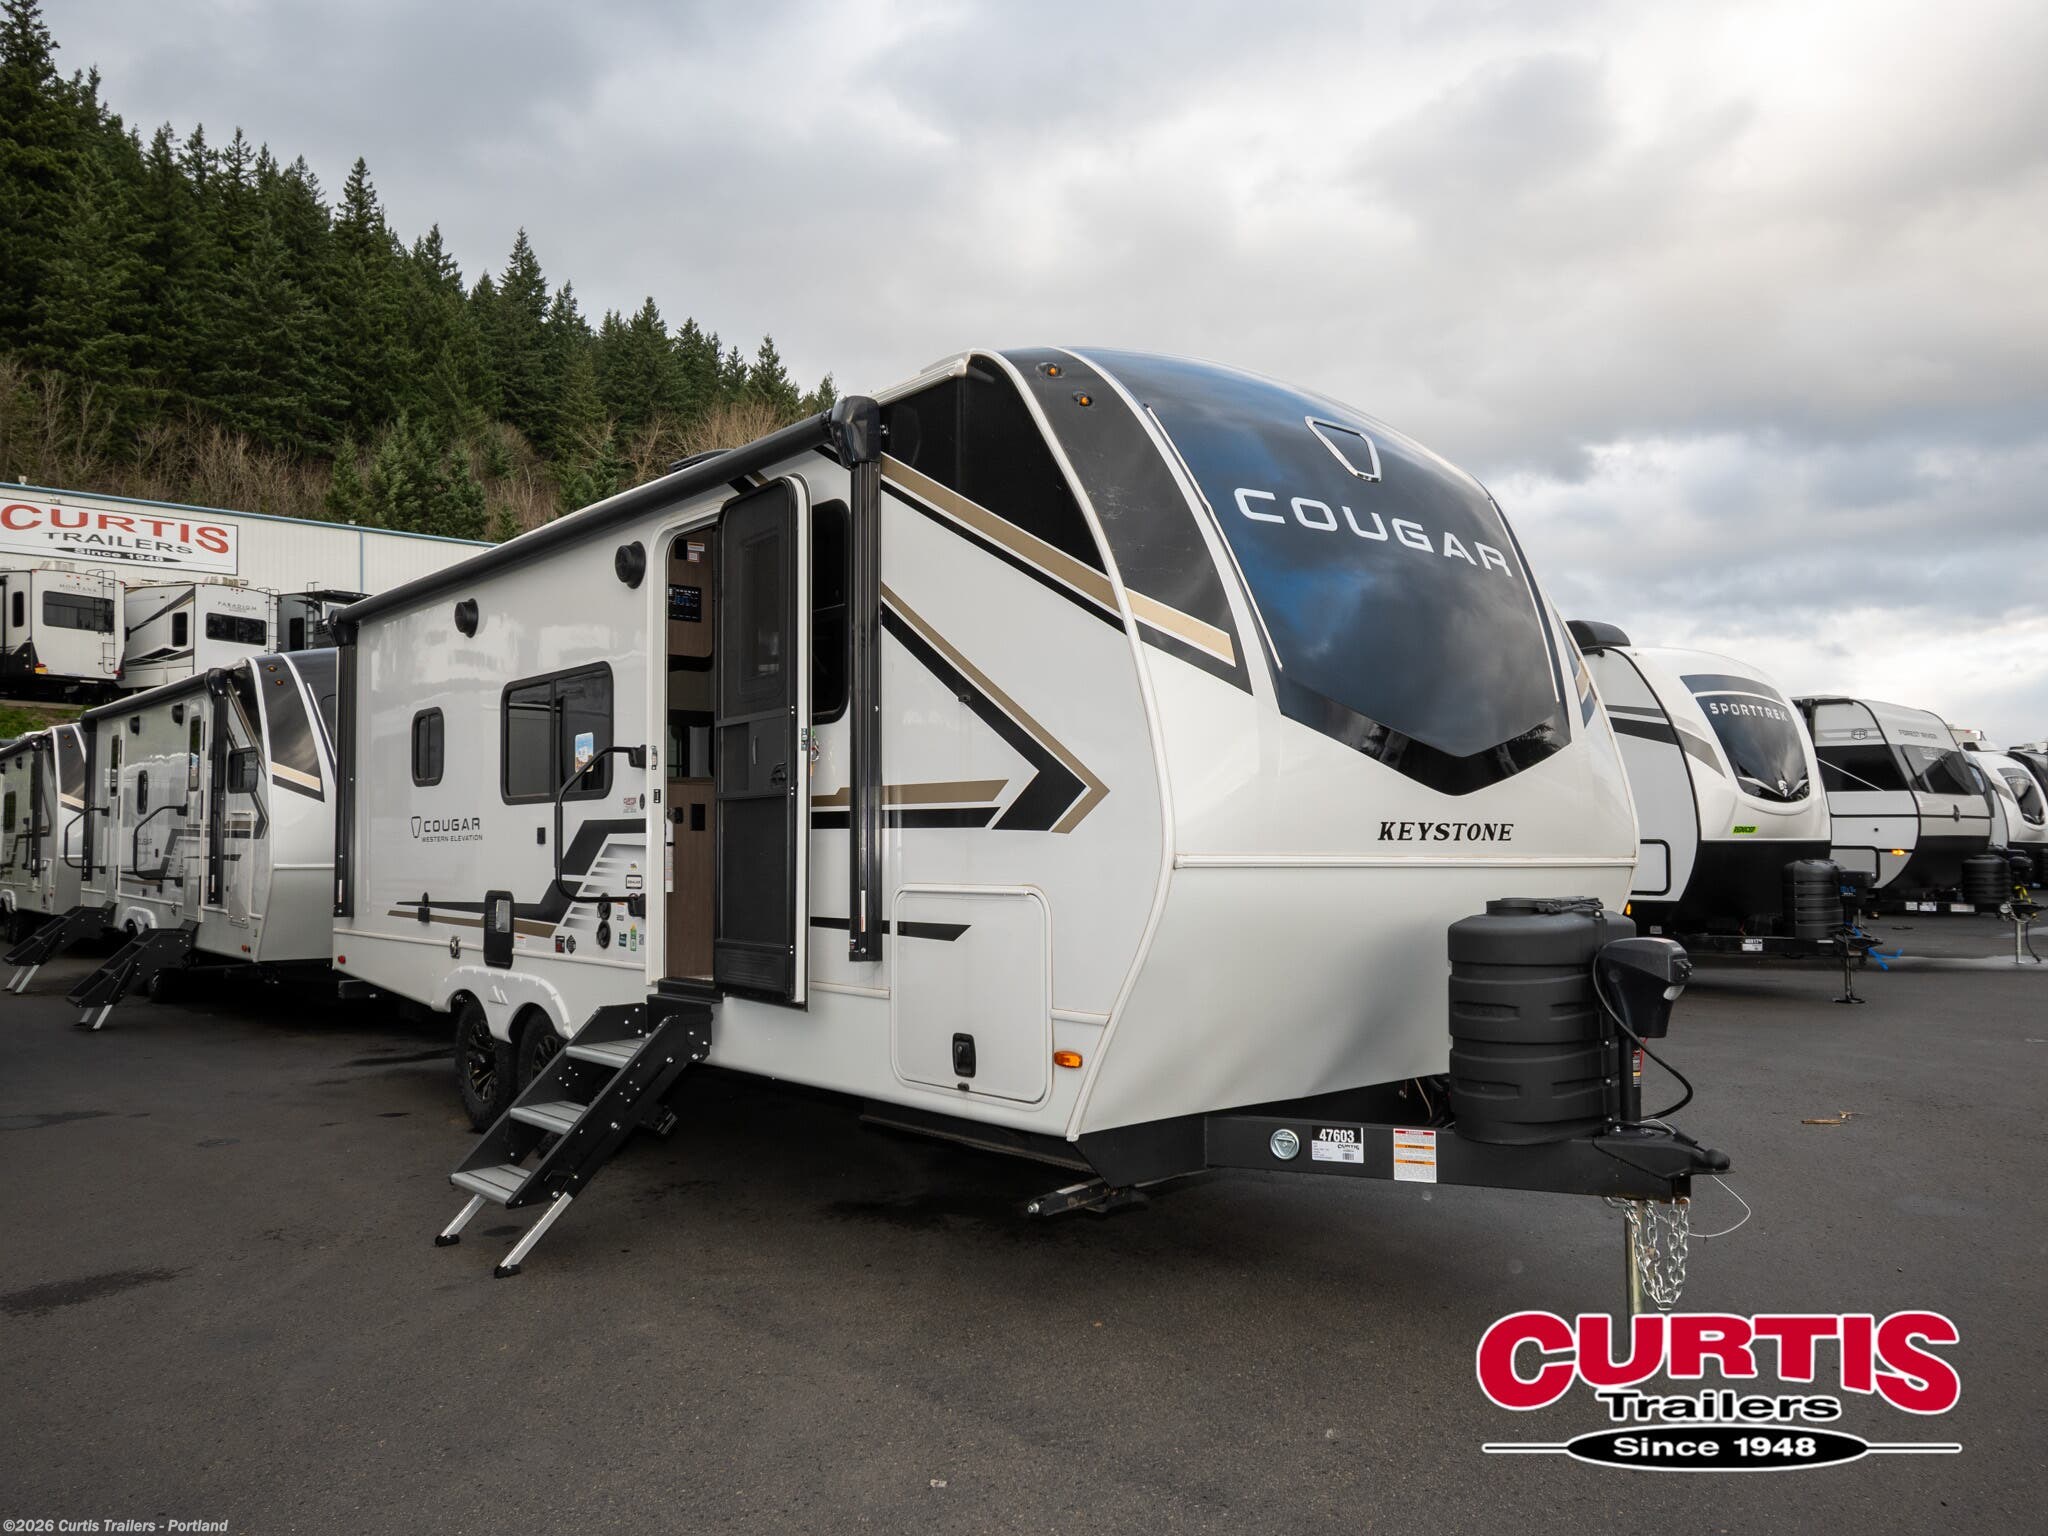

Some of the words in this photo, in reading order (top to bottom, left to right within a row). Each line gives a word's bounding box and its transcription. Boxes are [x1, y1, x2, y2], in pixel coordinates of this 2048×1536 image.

[1, 504, 229, 554] CURTIS
[1234, 487, 1513, 577] COUGAR
[42, 531, 193, 554] TRAILERS
[75, 547, 122, 559] Since
[127, 552, 165, 563] 1948
[1709, 702, 1788, 721] SPORTTREK
[423, 817, 480, 833] COUGAR
[1377, 821, 1514, 842] KEYSTONE
[422, 835, 449, 843] WESTERN
[450, 834, 483, 842] ELEVATION
[1319, 1127, 1355, 1144] 47603
